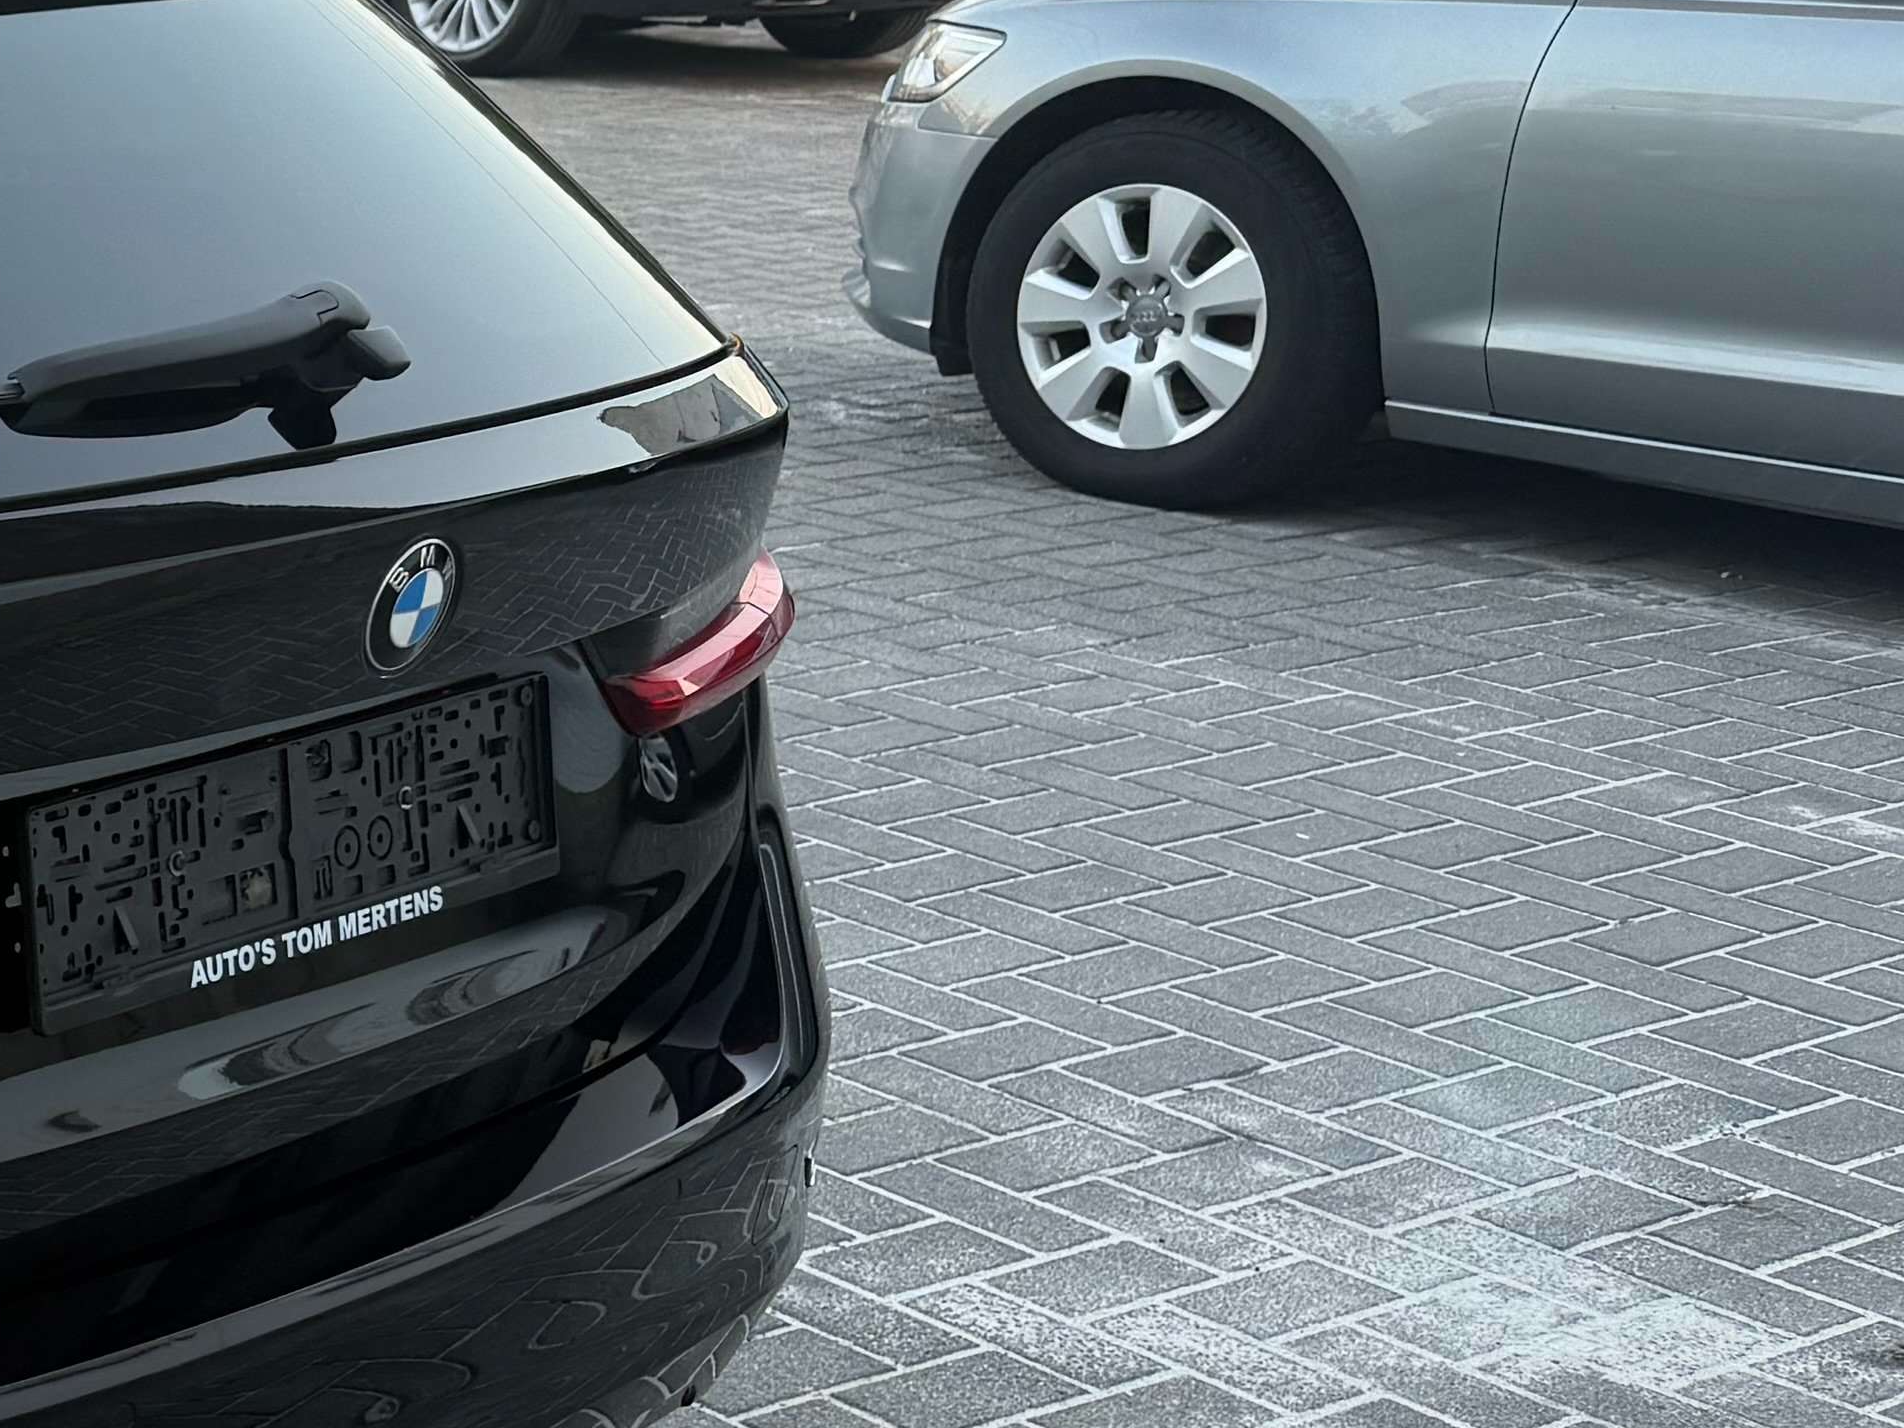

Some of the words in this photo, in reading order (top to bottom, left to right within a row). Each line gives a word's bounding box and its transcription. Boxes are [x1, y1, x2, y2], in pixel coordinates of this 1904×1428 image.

[190, 938, 277, 988] AUTO'S
[282, 920, 332, 958] TOM
[339, 885, 443, 941] MERTENS
